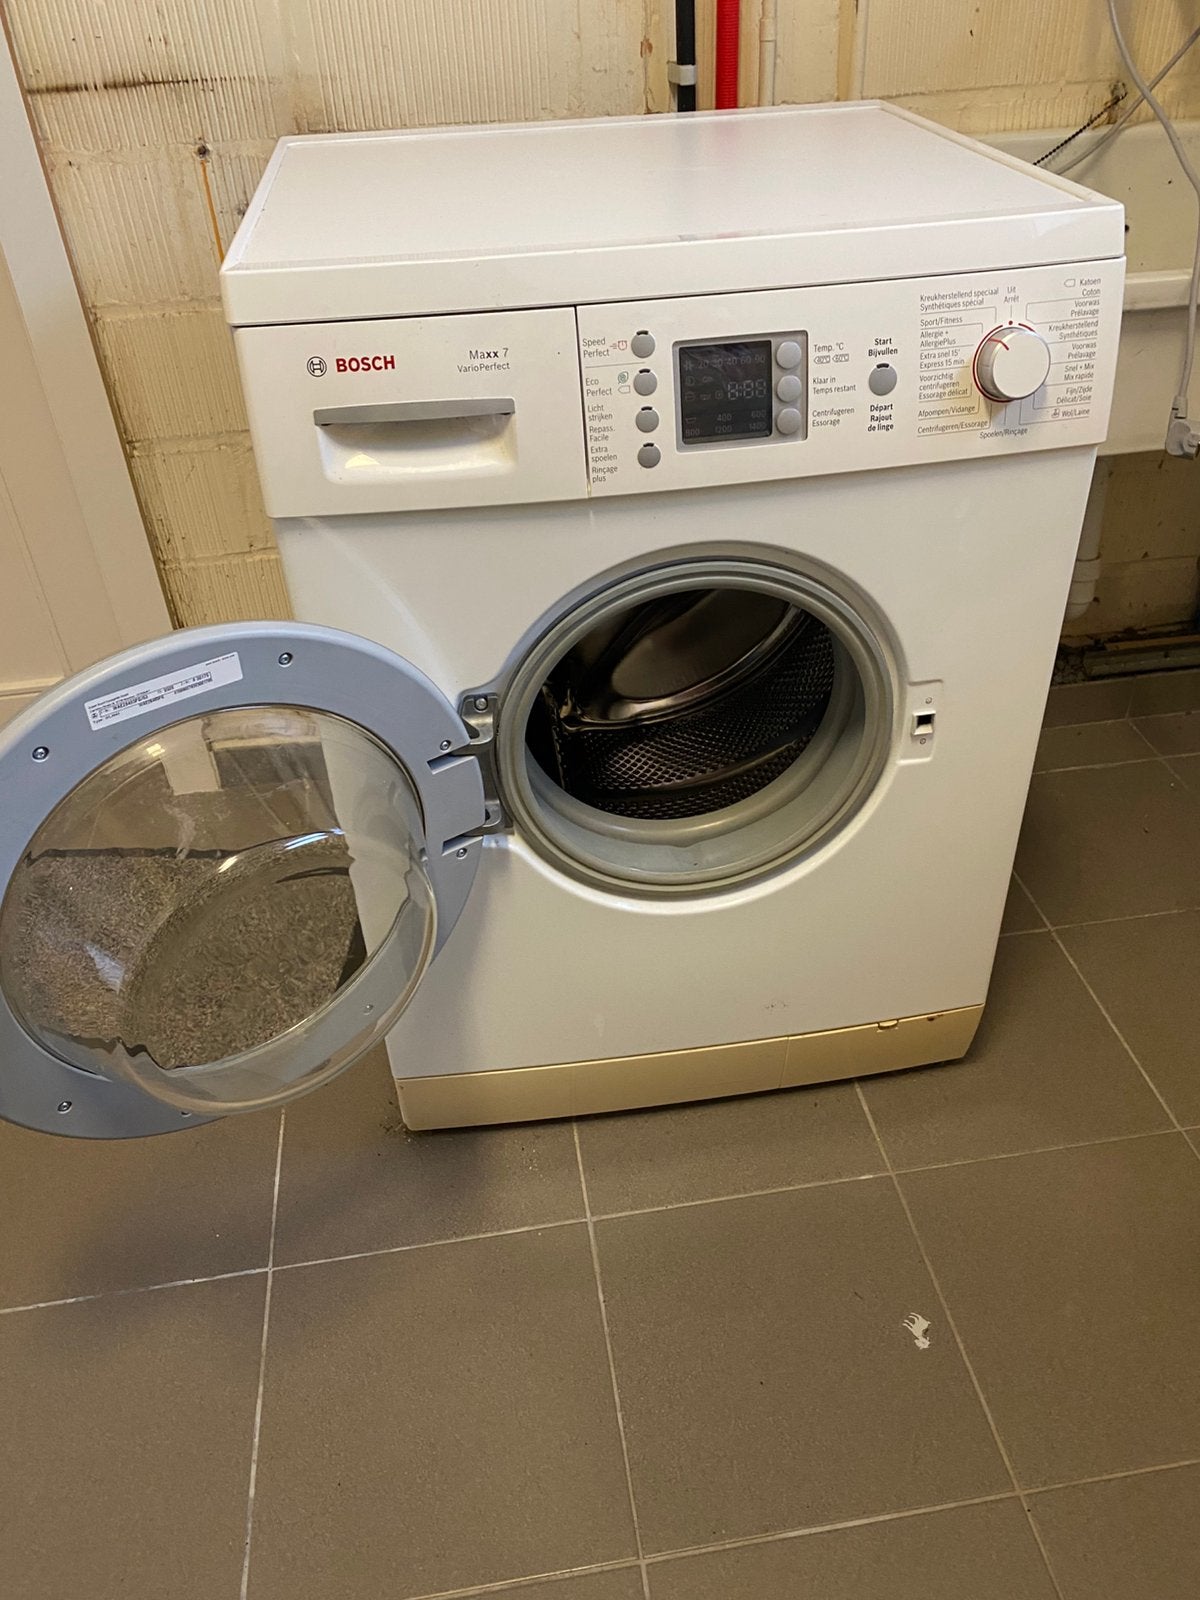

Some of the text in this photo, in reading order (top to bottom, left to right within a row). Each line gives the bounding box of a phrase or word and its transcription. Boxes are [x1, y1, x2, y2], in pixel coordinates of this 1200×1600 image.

[1080, 278, 1101, 286] Katoen
[920, 287, 999, 301] Kreukherstellend speciaal
[1007, 286, 1016, 294] Uit
[1082, 288, 1101, 297] Coton
[920, 298, 985, 312] Synthétiques spécial
[1071, 308, 1099, 317] Prélavage
[920, 317, 963, 327] Sport/Fitness
[1048, 320, 1099, 332] Kreukherstellend
[920, 330, 944, 339] Allergie
[1059, 329, 1098, 340] Synthétiques
[582, 337, 606, 347] Speed
[874, 337, 892, 346] Start
[920, 339, 956, 348] AllergiePlus
[1071, 342, 1097, 350] Voorwas
[469, 347, 509, 360] Maxx 7
[583, 348, 610, 358] Perfect
[868, 347, 898, 358] Bijvullen
[920, 352, 936, 360] Extra
[937, 349, 950, 358] snel
[1067, 351, 1096, 360] Prélavage
[335, 355, 395, 373] BOSCH
[457, 362, 511, 373] VarioPerfect
[920, 361, 944, 369] Express
[1064, 364, 1078, 372] Snel
[1084, 362, 1094, 370] Mix
[812, 376, 836, 385] Klaar in
[919, 372, 954, 382] Voorzichtig
[1064, 372, 1094, 381] Mix rapide
[585, 378, 599, 386] Eco
[919, 381, 960, 391] centrifugeren
[586, 387, 613, 397] Perfect
[812, 384, 856, 395] Temps restant
[919, 388, 968, 400] Essorage délicat
[587, 405, 604, 413] Licht
[812, 407, 855, 418] Centrifugeren
[869, 403, 893, 413] Départ
[918, 405, 975, 418] Afpompen/Vidange
[588, 413, 613, 423] strijken
[812, 418, 840, 427] Essorage
[870, 414, 892, 423] Rajout
[589, 425, 616, 434] Repass.
[877, 423, 894, 432] linge
[917, 420, 988, 434] Centrifugeren/Essorage
[589, 434, 609, 442] Facile
[980, 427, 1028, 439] Spoelen/Rinçage
[590, 446, 608, 454] Extra
[591, 454, 618, 463] spoelen
[591, 466, 618, 475] Rinçage
[592, 475, 607, 483] plus
